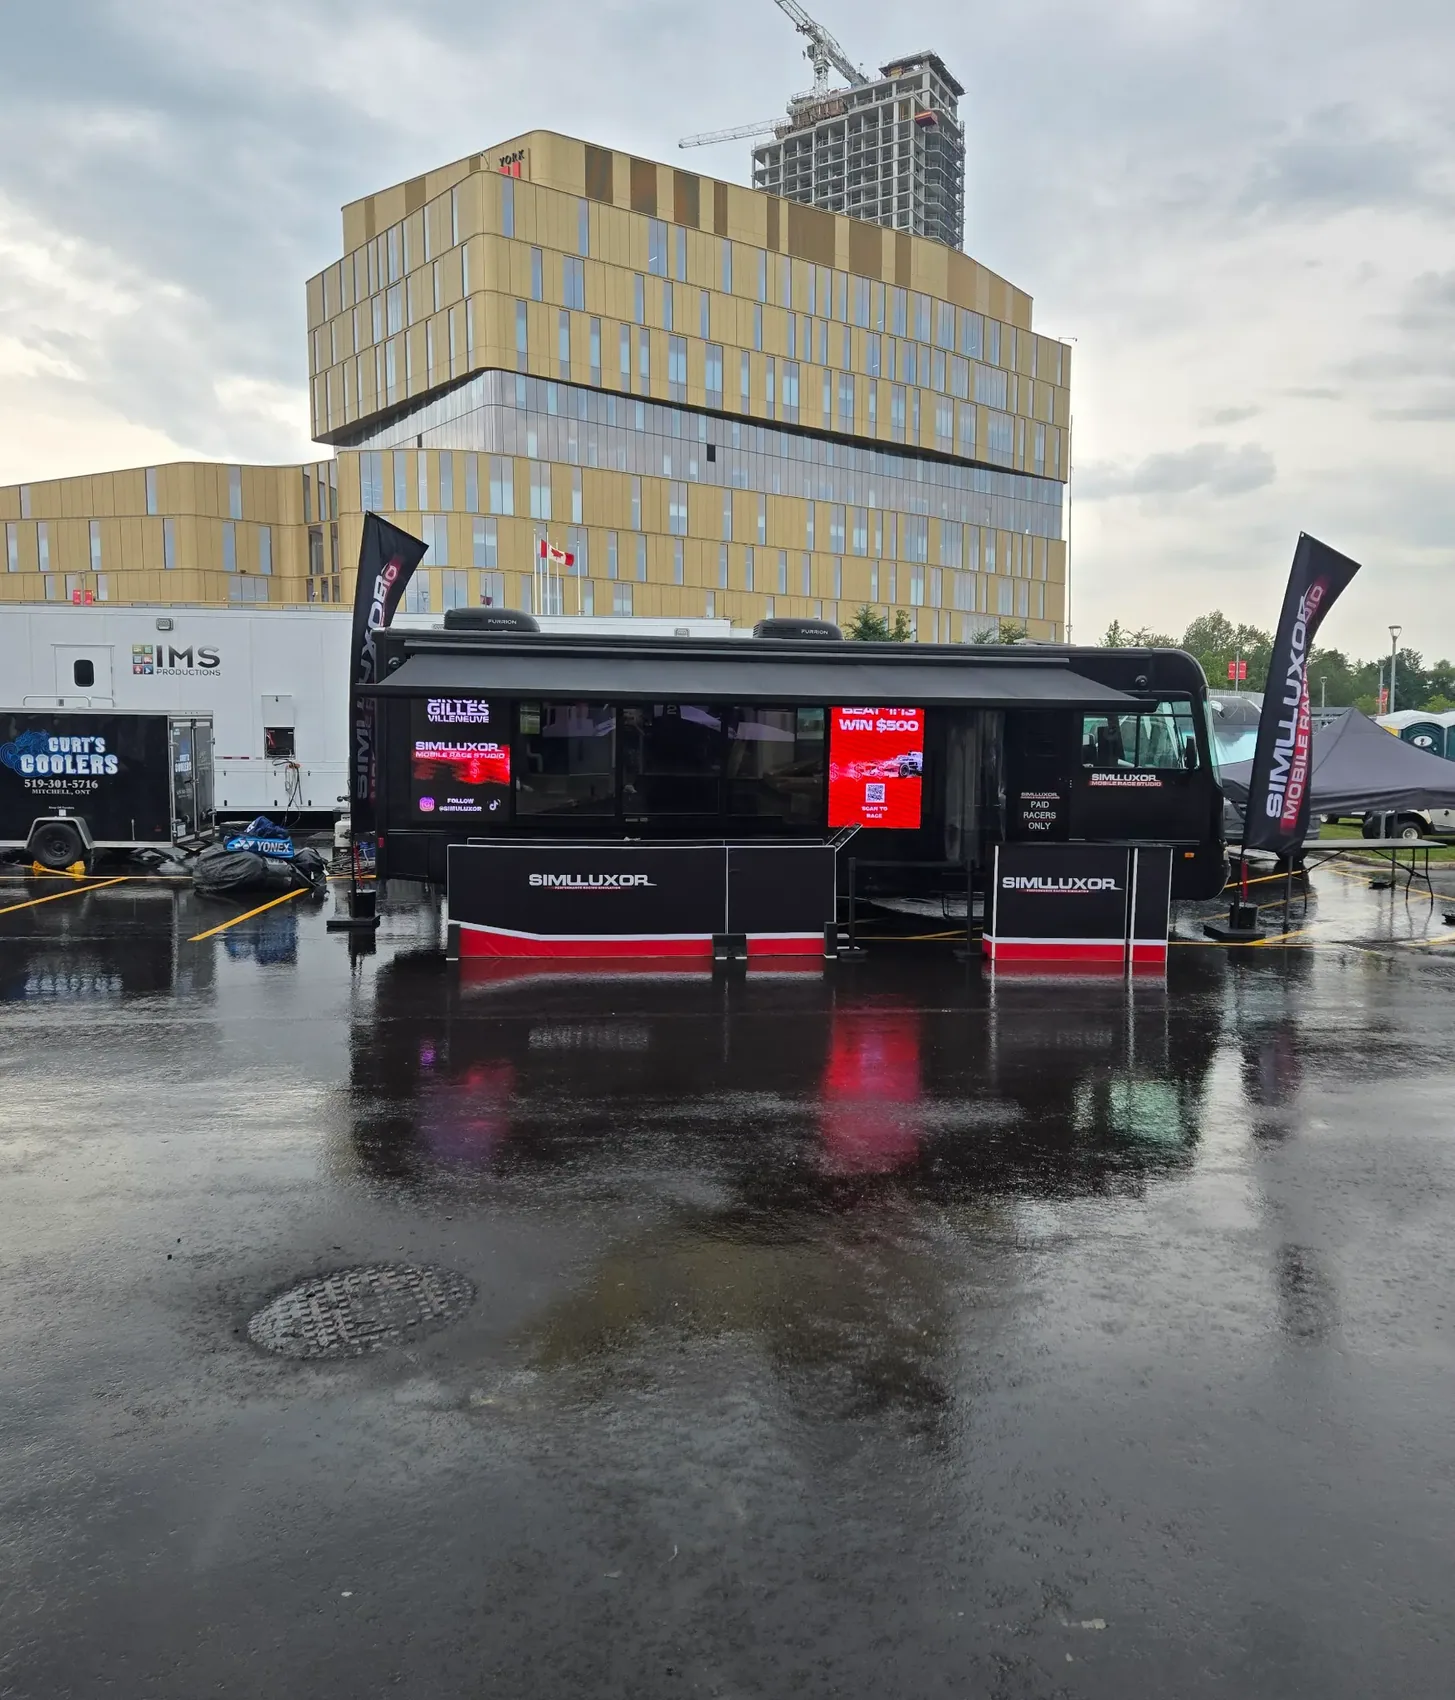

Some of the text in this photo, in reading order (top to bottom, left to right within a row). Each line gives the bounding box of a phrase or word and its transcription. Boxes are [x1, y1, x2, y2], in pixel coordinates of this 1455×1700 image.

[499, 149, 524, 167] YORK
[156, 645, 221, 668] IMS
[156, 668, 221, 676] PRODUCTIONS
[427, 702, 490, 716] GILLES
[427, 714, 489, 724] VILLENEUVE
[839, 717, 919, 733] WIN $500
[47, 736, 106, 754] CURT'S
[415, 751, 447, 759] MOBILE
[473, 752, 505, 760] STUDIO
[20, 753, 119, 775] COOLERS
[1283, 734, 1309, 820] MOBILE
[24, 779, 99, 789] 519-301-5716
[31, 788, 74, 796] MITCHELL,
[1030, 800, 1050, 809] PAID
[1023, 811, 1057, 819] RACERS
[1028, 822, 1051, 830] ONLY
[257, 841, 290, 853] YONEX
